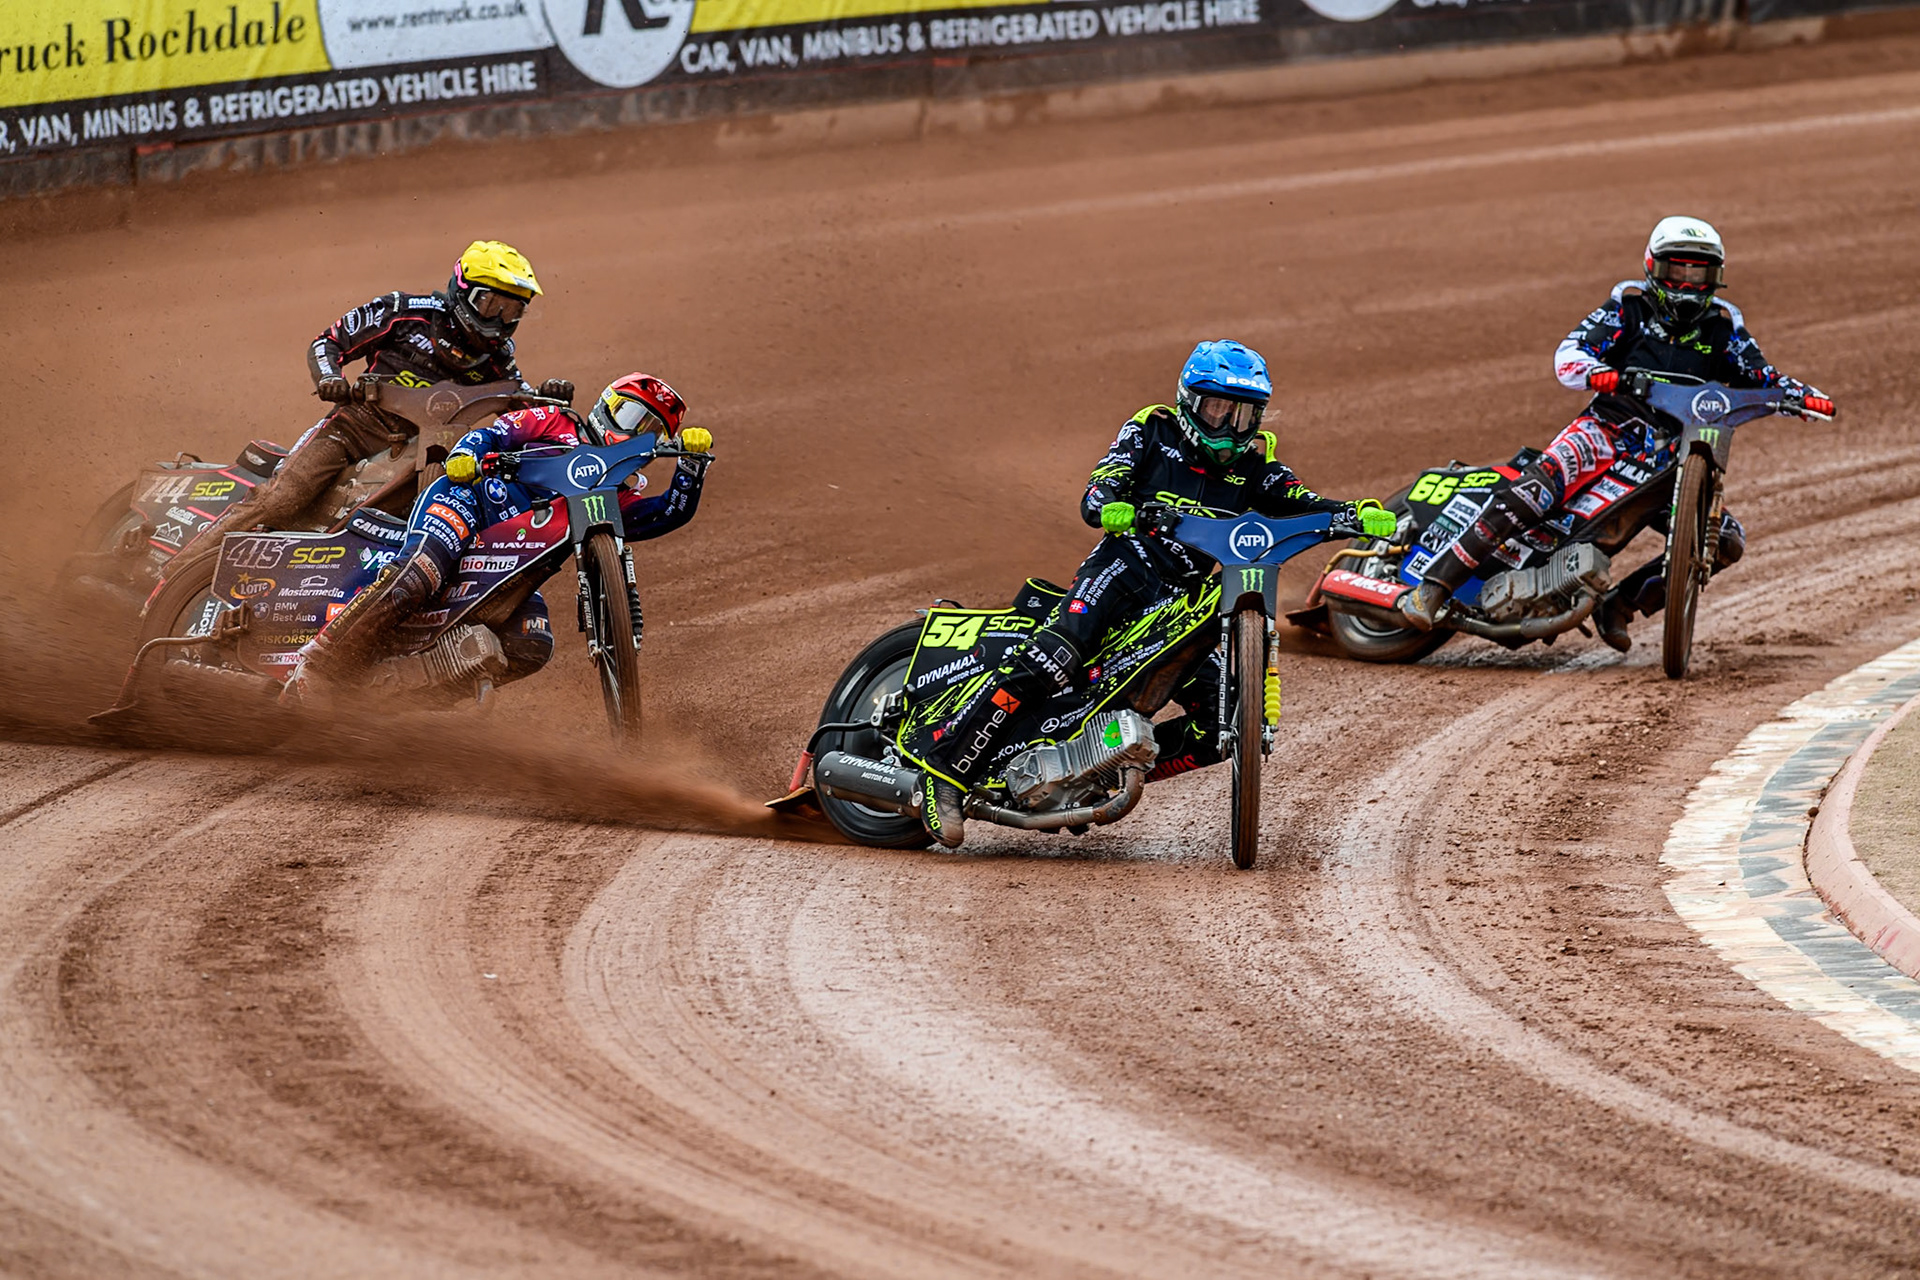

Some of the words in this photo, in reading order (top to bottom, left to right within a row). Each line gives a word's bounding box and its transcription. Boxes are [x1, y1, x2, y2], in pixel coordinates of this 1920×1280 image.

[0, 23, 87, 73] ruck
[102, 2, 306, 64] Rochdale
[680, 42, 737, 75] CAR,
[738, 34, 799, 69] VAN,
[802, 23, 903, 61] MINIBUS
[906, 21, 927, 52] &
[929, 8, 1100, 49] REFRIGERATED
[1101, 2, 1202, 36] VEHICLE
[1203, 0, 1261, 27] HIRE
[19, 113, 79, 147] VAN,
[83, 101, 178, 139] MINIBUS
[183, 97, 205, 128] &
[209, 72, 379, 124] REFRIGERATED
[382, 66, 479, 104] VEHICLE
[481, 60, 537, 96] HIRE
[1226, 376, 1269, 392] BOLL
[573, 464, 600, 480] ATPI
[1458, 472, 1501, 488] SGP
[188, 481, 236, 497] SGP
[1407, 473, 1460, 505] 66
[432, 493, 477, 529] CARGER
[431, 505, 466, 536] KUKA
[491, 541, 547, 550] MAVER
[1235, 534, 1266, 548] ATPI
[289, 546, 347, 564] SGP
[460, 556, 516, 572] biomus
[277, 586, 346, 599] Mastermedia
[273, 602, 299, 611] BMW
[197, 600, 216, 636] ROFIT
[272, 613, 293, 622] Best
[294, 613, 317, 622] Auto
[985, 616, 1036, 631] SGP
[922, 616, 986, 651] 54
[916, 653, 978, 689] DYNAMAX
[946, 669, 971, 686] MOTOR
[970, 663, 986, 676] OILS
[838, 755, 899, 776] DYNAMAX
[860, 771, 882, 783] MOTOR
[881, 775, 897, 785] OILS
